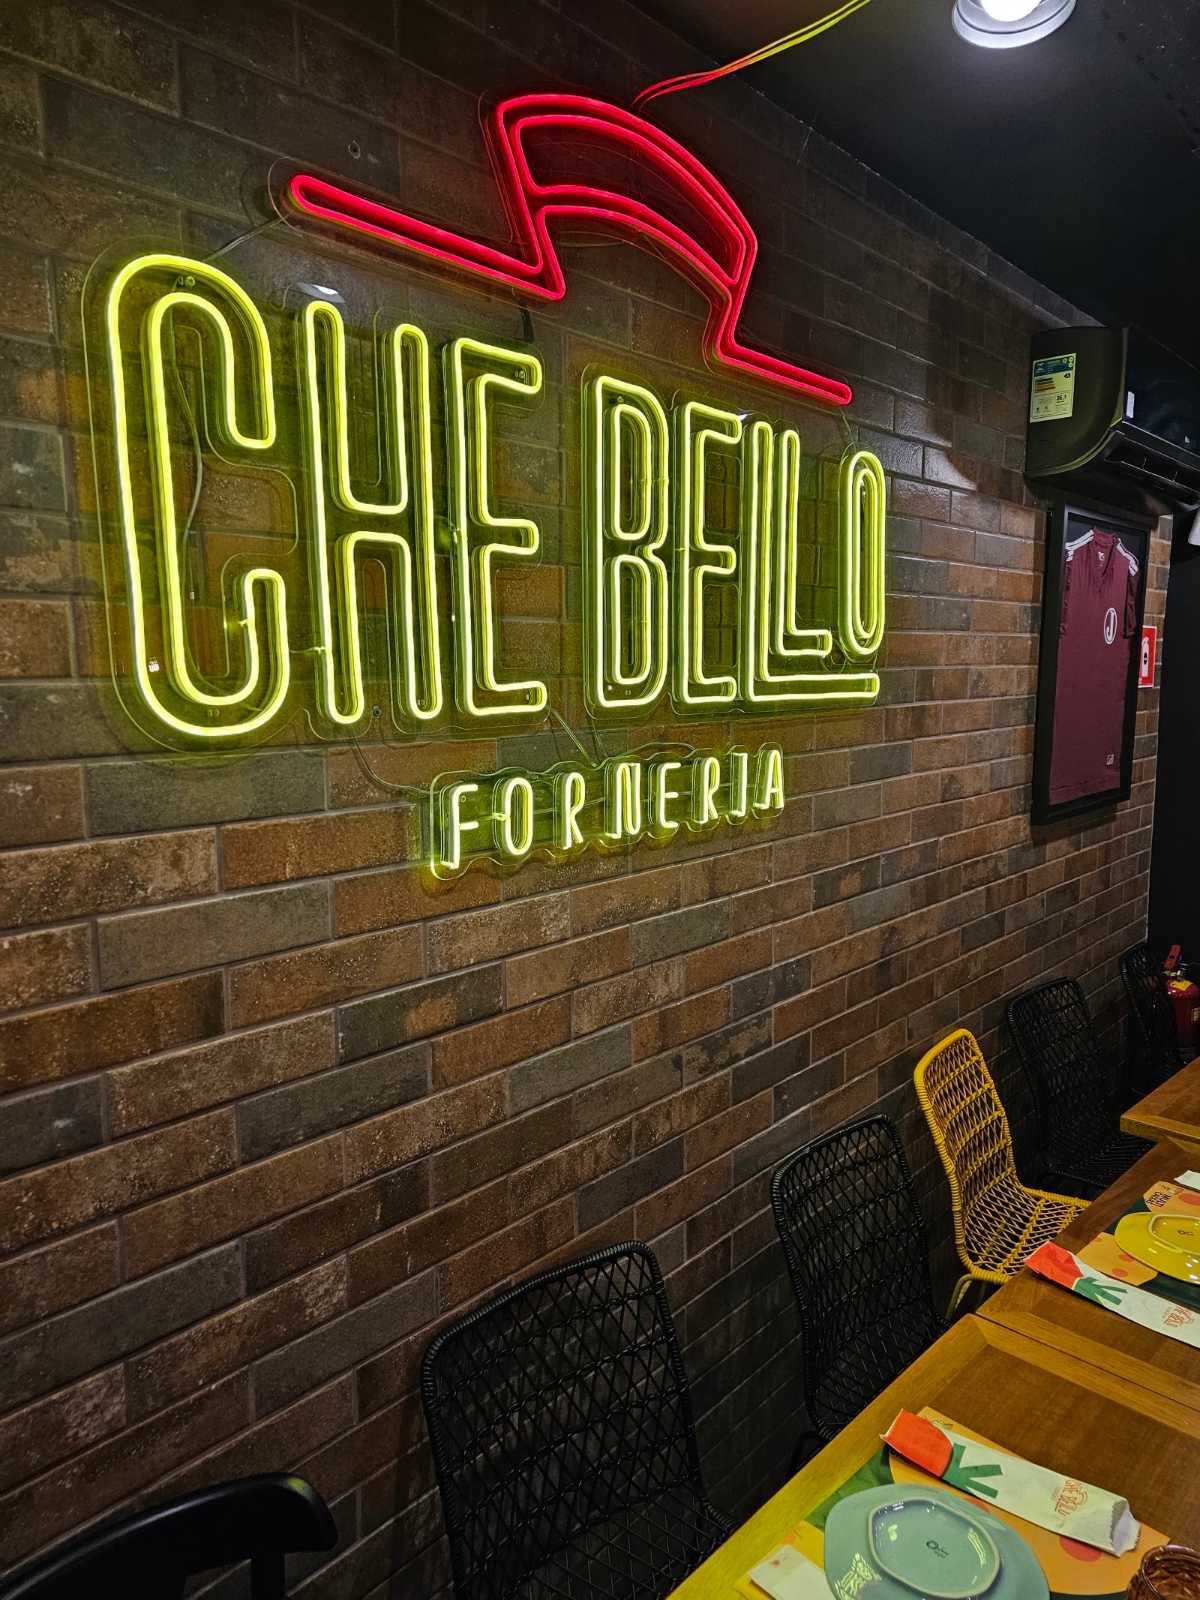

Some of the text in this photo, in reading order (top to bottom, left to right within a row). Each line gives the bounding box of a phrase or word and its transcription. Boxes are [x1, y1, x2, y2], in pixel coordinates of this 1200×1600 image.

[107, 254, 887, 737] CHE BELLO
[440, 749, 785, 869] FORNERIA
